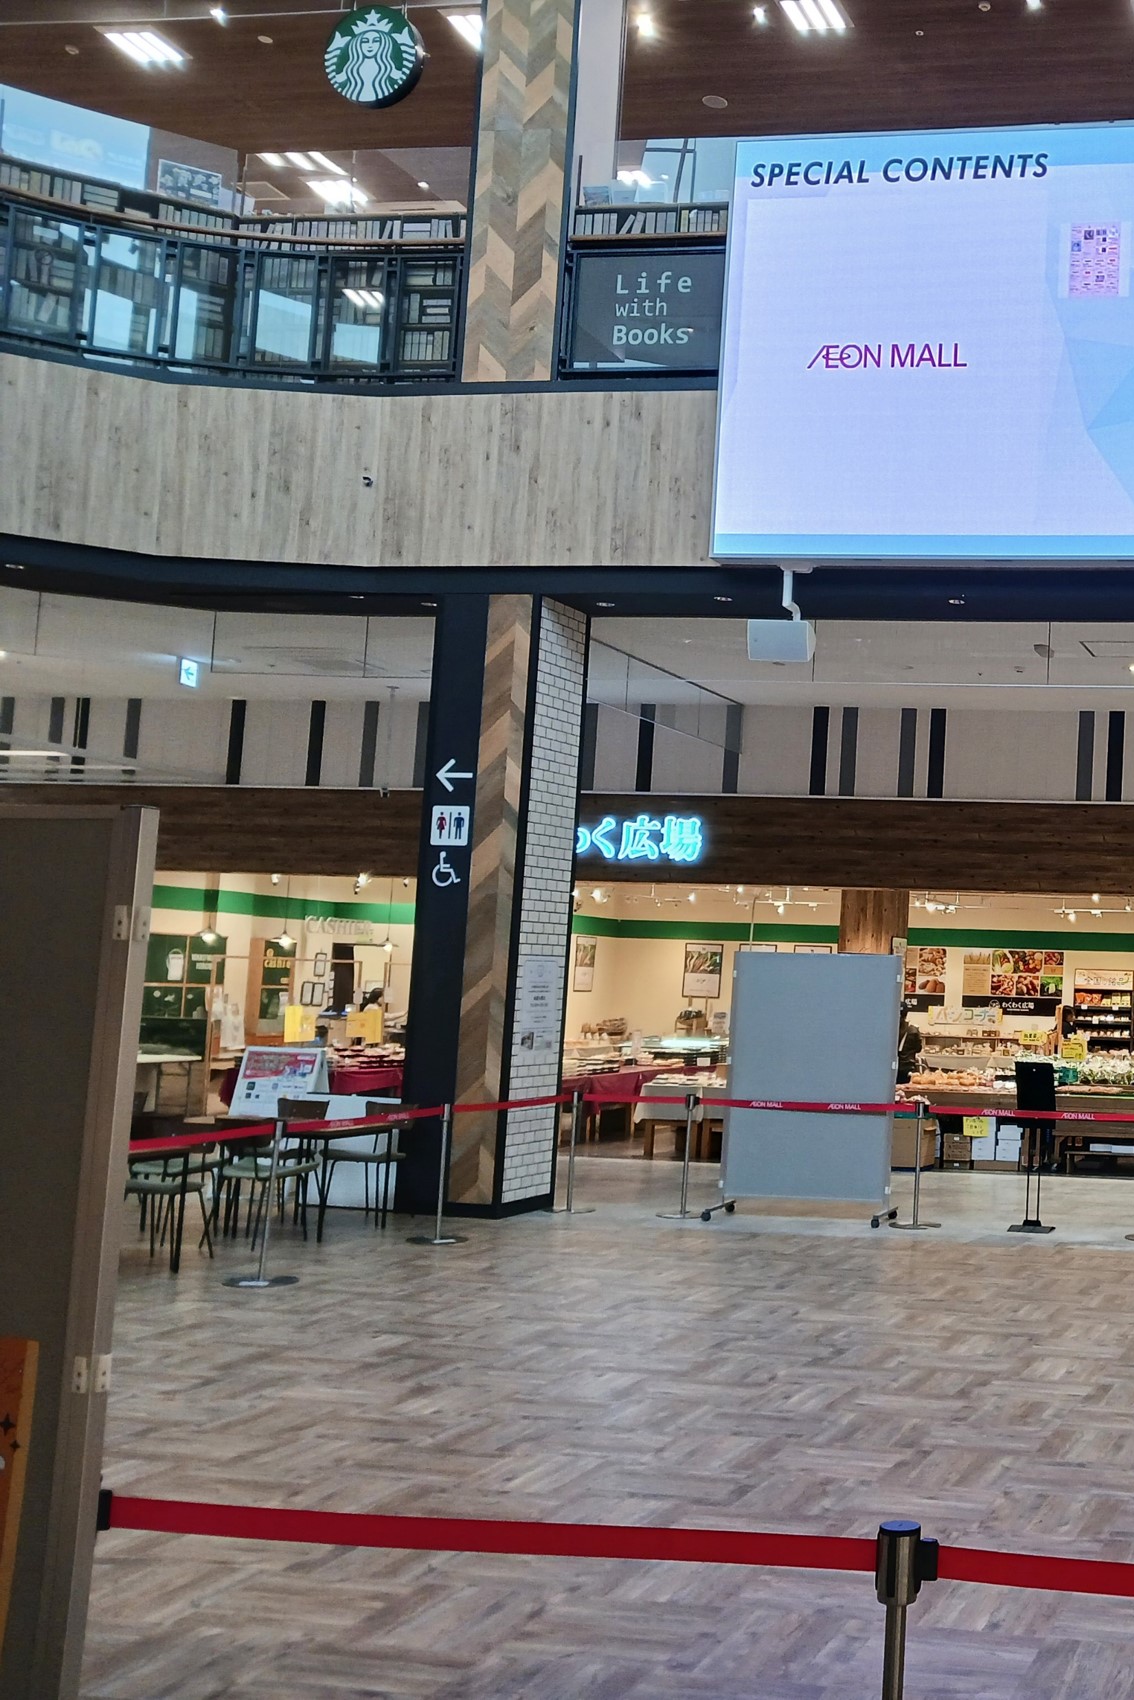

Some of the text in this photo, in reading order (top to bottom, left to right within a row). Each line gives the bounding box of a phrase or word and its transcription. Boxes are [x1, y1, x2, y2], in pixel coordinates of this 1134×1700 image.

[750, 152, 1049, 188] SPECIAL CONTENTS
[615, 271, 693, 294] Life
[614, 298, 668, 317] with
[612, 323, 690, 346] Books
[890, 342, 968, 368] MALL
[998, 1109, 1016, 1117] MALL
[1078, 1113, 1096, 1121] MALL
